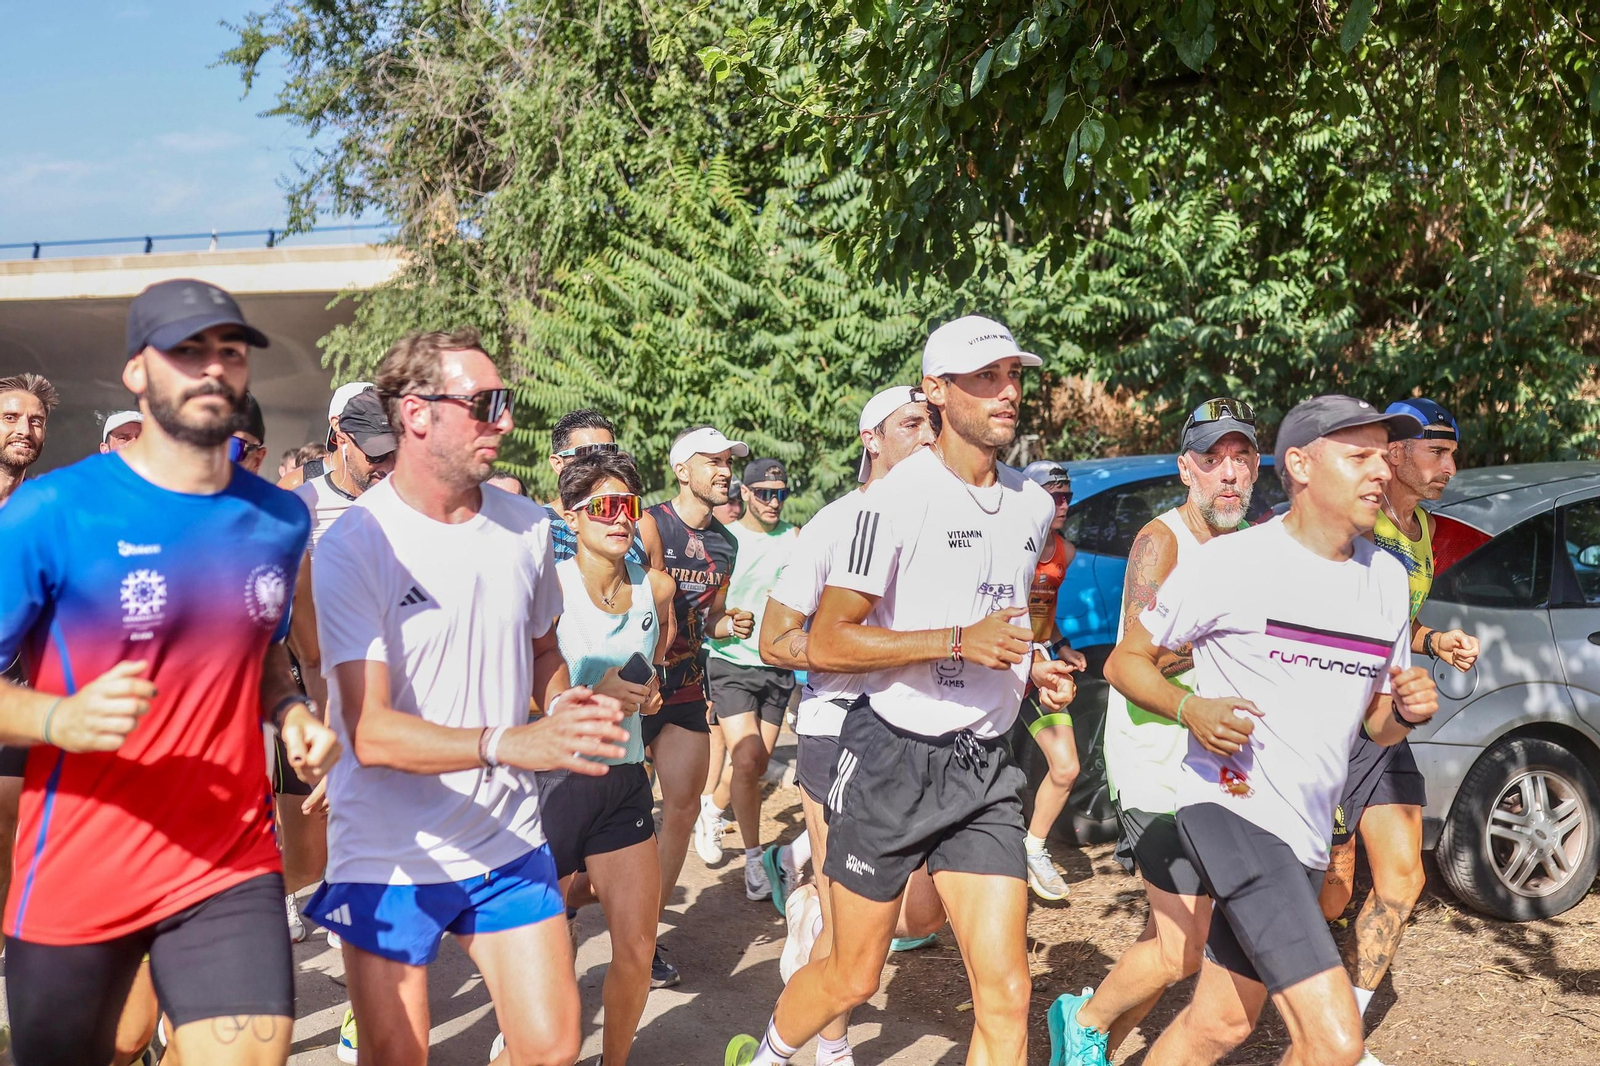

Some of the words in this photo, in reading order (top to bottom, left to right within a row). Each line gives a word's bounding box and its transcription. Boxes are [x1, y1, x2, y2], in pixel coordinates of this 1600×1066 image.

[968, 334, 998, 345] VITAMIN
[946, 530, 983, 539] VITAMIN
[948, 539, 972, 549] WELL
[937, 676, 965, 689] JAMES
